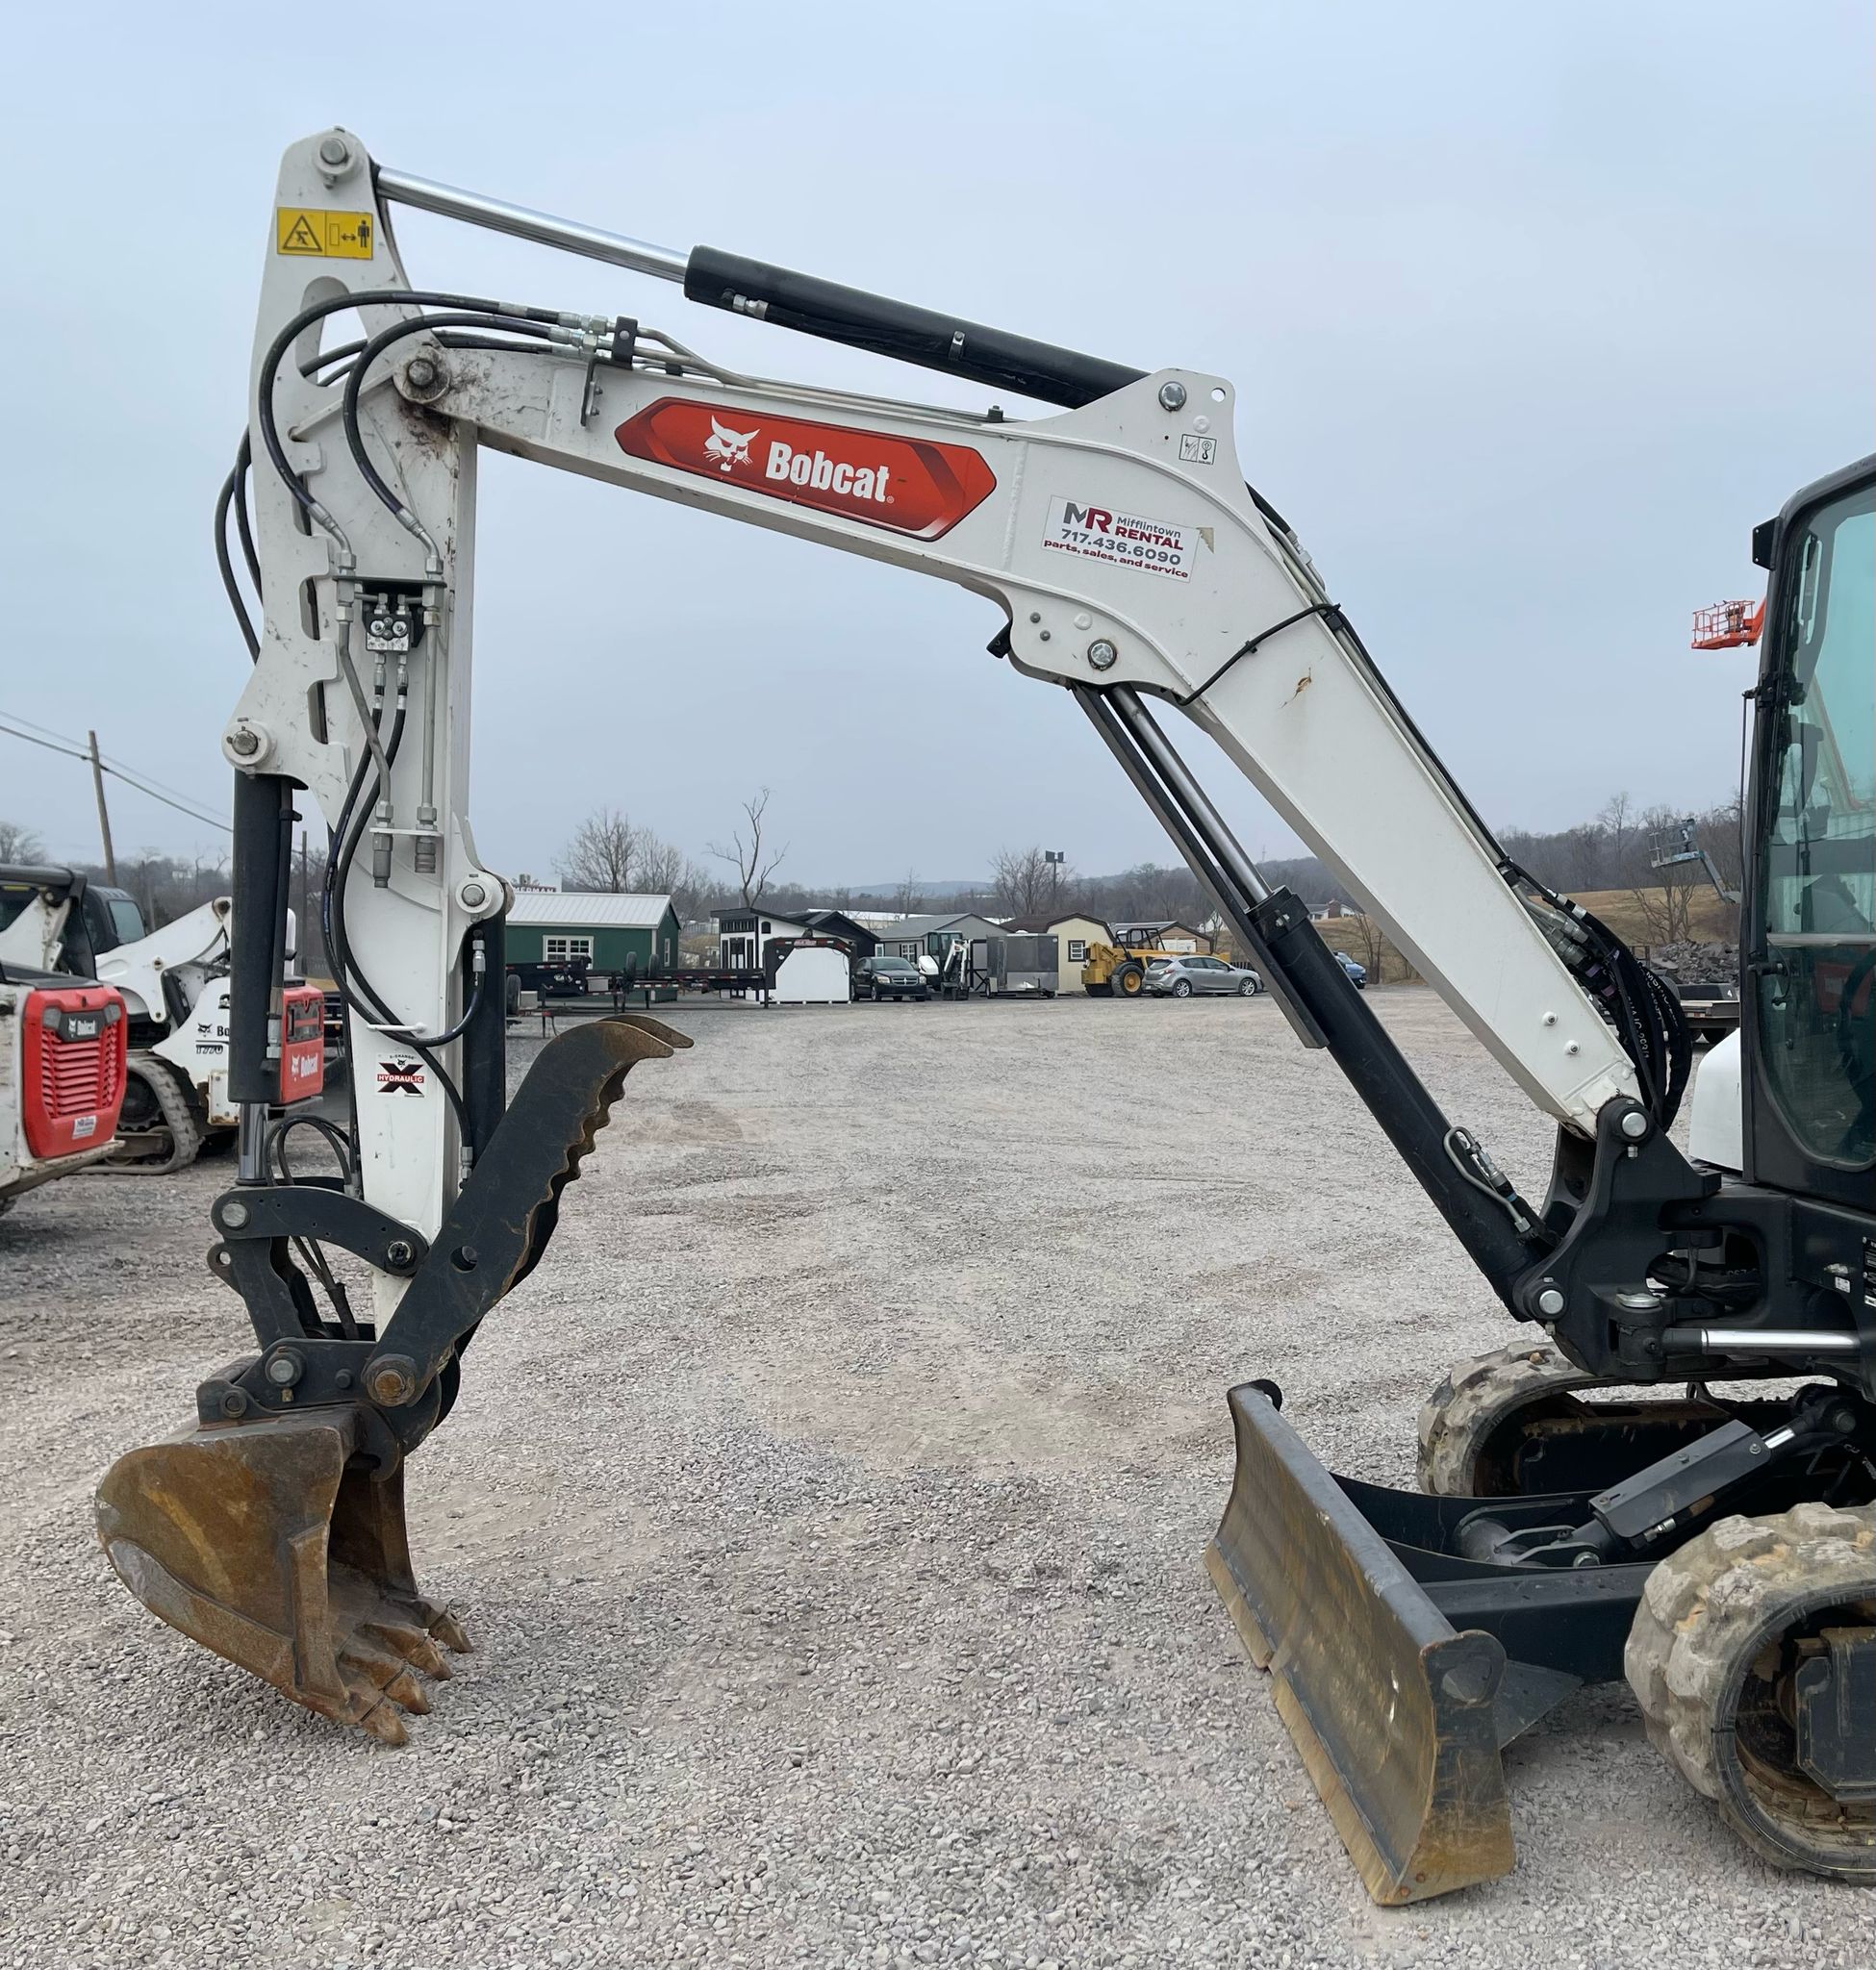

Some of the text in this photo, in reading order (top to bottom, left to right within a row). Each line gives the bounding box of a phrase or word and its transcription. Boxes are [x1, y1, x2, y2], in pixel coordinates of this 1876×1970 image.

[766, 441, 890, 503] Bobcat
[1063, 501, 1113, 534] MR
[1117, 516, 1181, 539] Mifflintown
[1061, 529, 1181, 566] 717.436.6090
[1115, 525, 1184, 550] RENTAL
[1044, 539, 1189, 578] parts, sales, and service
[378, 1074, 423, 1083] HYDRAULIC
